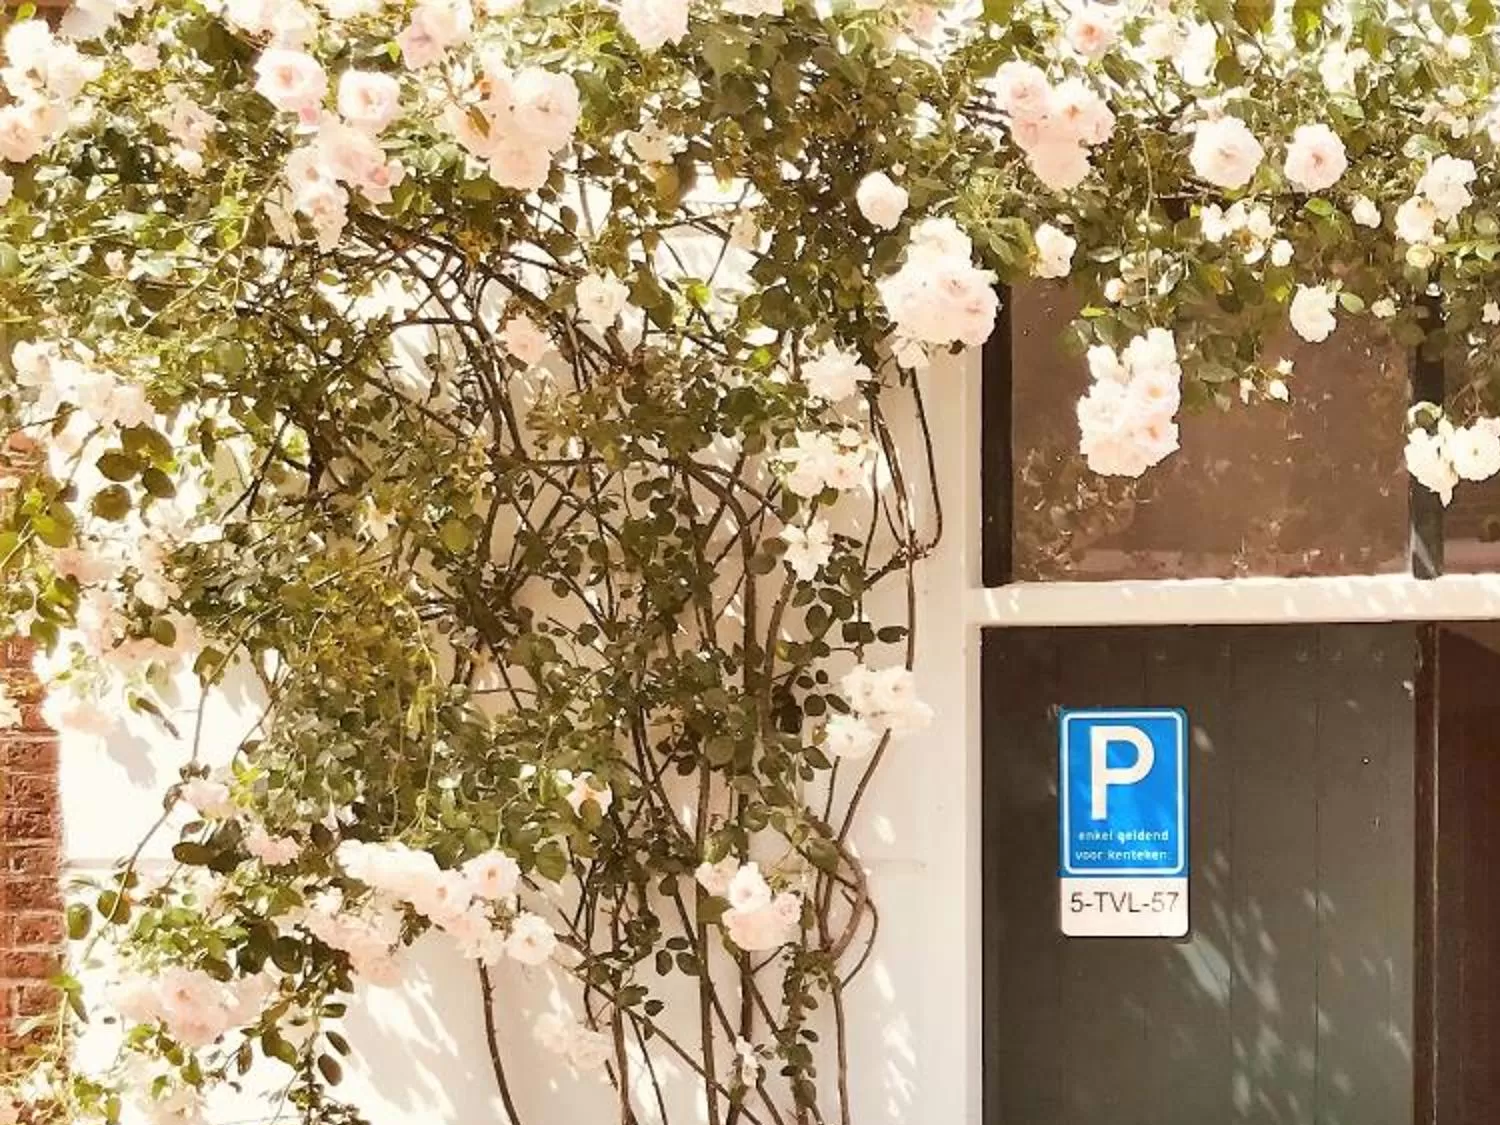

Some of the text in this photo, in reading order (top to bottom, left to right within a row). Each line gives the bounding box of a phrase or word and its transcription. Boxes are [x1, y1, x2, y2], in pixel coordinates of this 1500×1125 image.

[1090, 725, 1155, 820] P
[1078, 828, 1169, 845] enkel geldend
[1075, 850, 1103, 861] voor
[1071, 891, 1180, 913] 5-TVL-57
